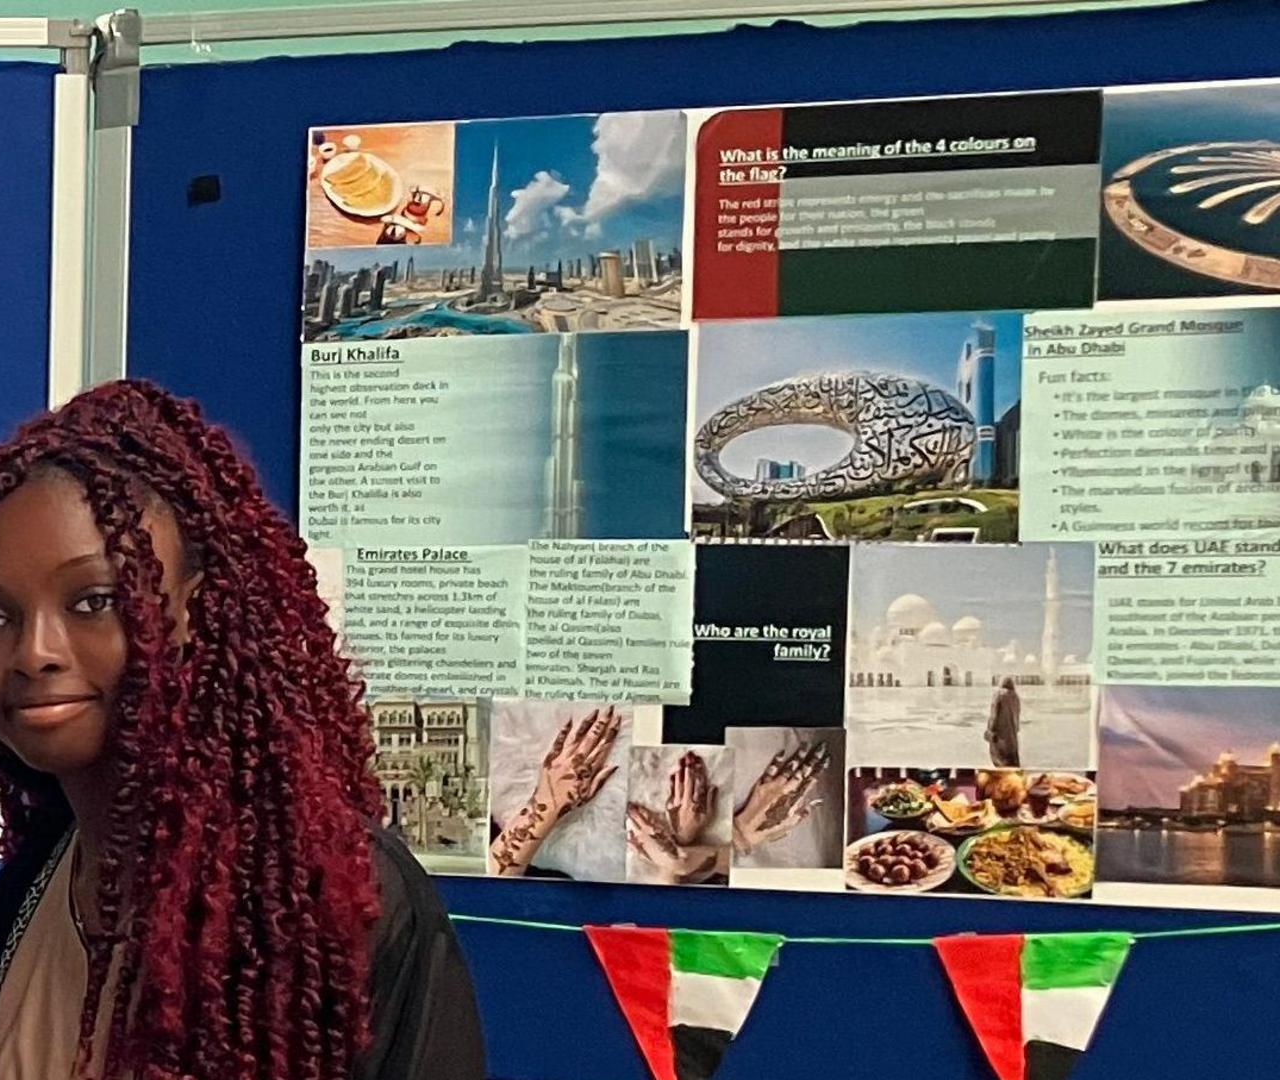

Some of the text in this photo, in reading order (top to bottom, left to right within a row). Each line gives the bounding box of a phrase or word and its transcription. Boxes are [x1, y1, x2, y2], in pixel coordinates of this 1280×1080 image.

[720, 136, 1036, 162] What is the meaning of the 4 colours on
[720, 166, 787, 182] the flag?
[719, 199, 760, 209] The red
[718, 214, 776, 224] the people
[718, 226, 772, 238] stands for
[718, 242, 732, 251] for
[1025, 320, 1243, 338] Sheikh Zayed Grand Mosque
[1047, 342, 1076, 354] Abu
[1082, 341, 1124, 354] Dhabi
[311, 346, 400, 364] Burj Khalifa
[310, 368, 400, 380] This is the second
[1038, 370, 1111, 383] Fun facts:
[310, 385, 346, 395] highest
[350, 382, 410, 392] observation
[439, 380, 449, 390] in
[1086, 391, 1110, 401] the
[1113, 390, 1159, 403] largest
[1164, 389, 1220, 400] mosque
[309, 422, 415, 434] only the city but also
[308, 490, 325, 499] the
[328, 490, 348, 501] Burj
[392, 488, 399, 498] is
[401, 488, 422, 498] also
[532, 542, 548, 550] The
[598, 542, 636, 552] branch
[638, 542, 648, 552] of
[652, 543, 669, 552] the
[1098, 542, 1144, 555] What
[1149, 542, 1188, 554] does
[1194, 540, 1230, 554] UAE
[357, 548, 468, 561] Emirates Palace
[346, 565, 481, 576] This grand hotel house has
[530, 568, 546, 578] the
[549, 569, 579, 580] ruling
[582, 569, 614, 580] family
[616, 569, 628, 578] of
[630, 570, 651, 578] Abu
[1098, 560, 1267, 575] and the 7 emirates?
[366, 579, 397, 590] luxury
[439, 578, 474, 590] private
[478, 578, 508, 588] beach
[344, 592, 366, 601] that
[368, 592, 414, 601] stretches
[418, 592, 448, 601] across
[486, 592, 497, 601] of
[694, 624, 832, 640] Who are the royal
[389, 645, 446, 656] the palaces
[526, 650, 613, 660] two of the seven
[774, 643, 831, 660] family?
